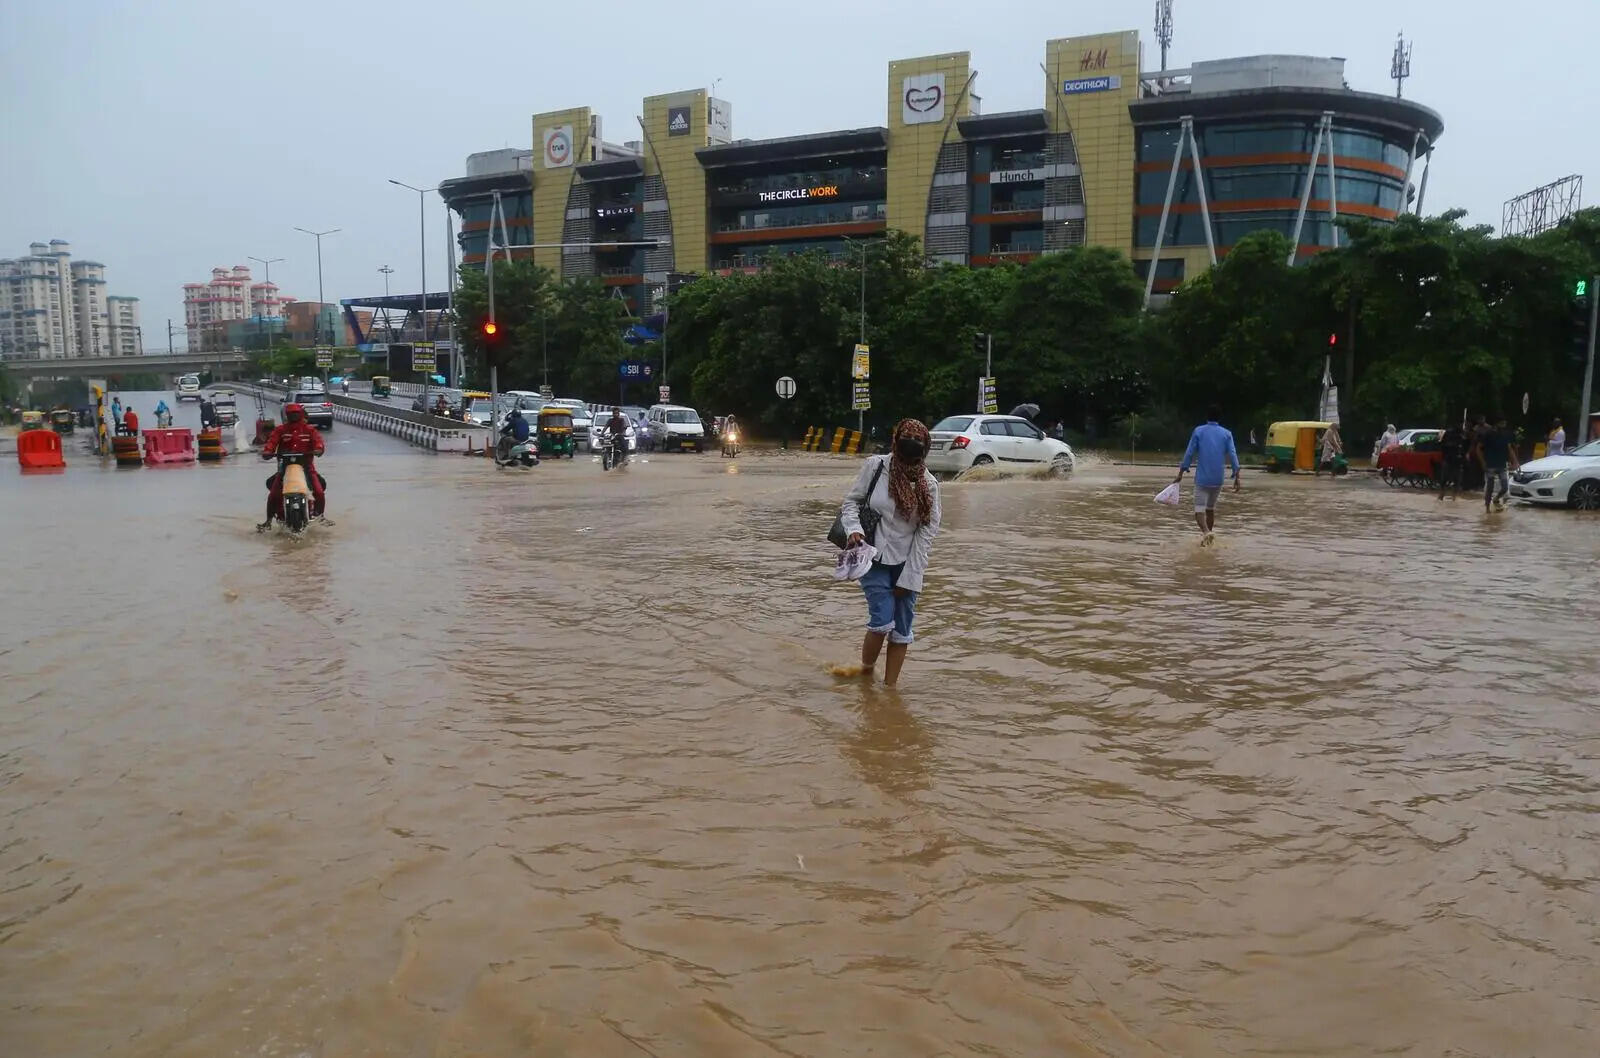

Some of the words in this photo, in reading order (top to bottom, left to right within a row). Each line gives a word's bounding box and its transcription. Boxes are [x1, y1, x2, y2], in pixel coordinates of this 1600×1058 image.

[1000, 169, 1034, 182] Hunch
[606, 207, 634, 215] BLADE
[627, 365, 639, 375] SBI
